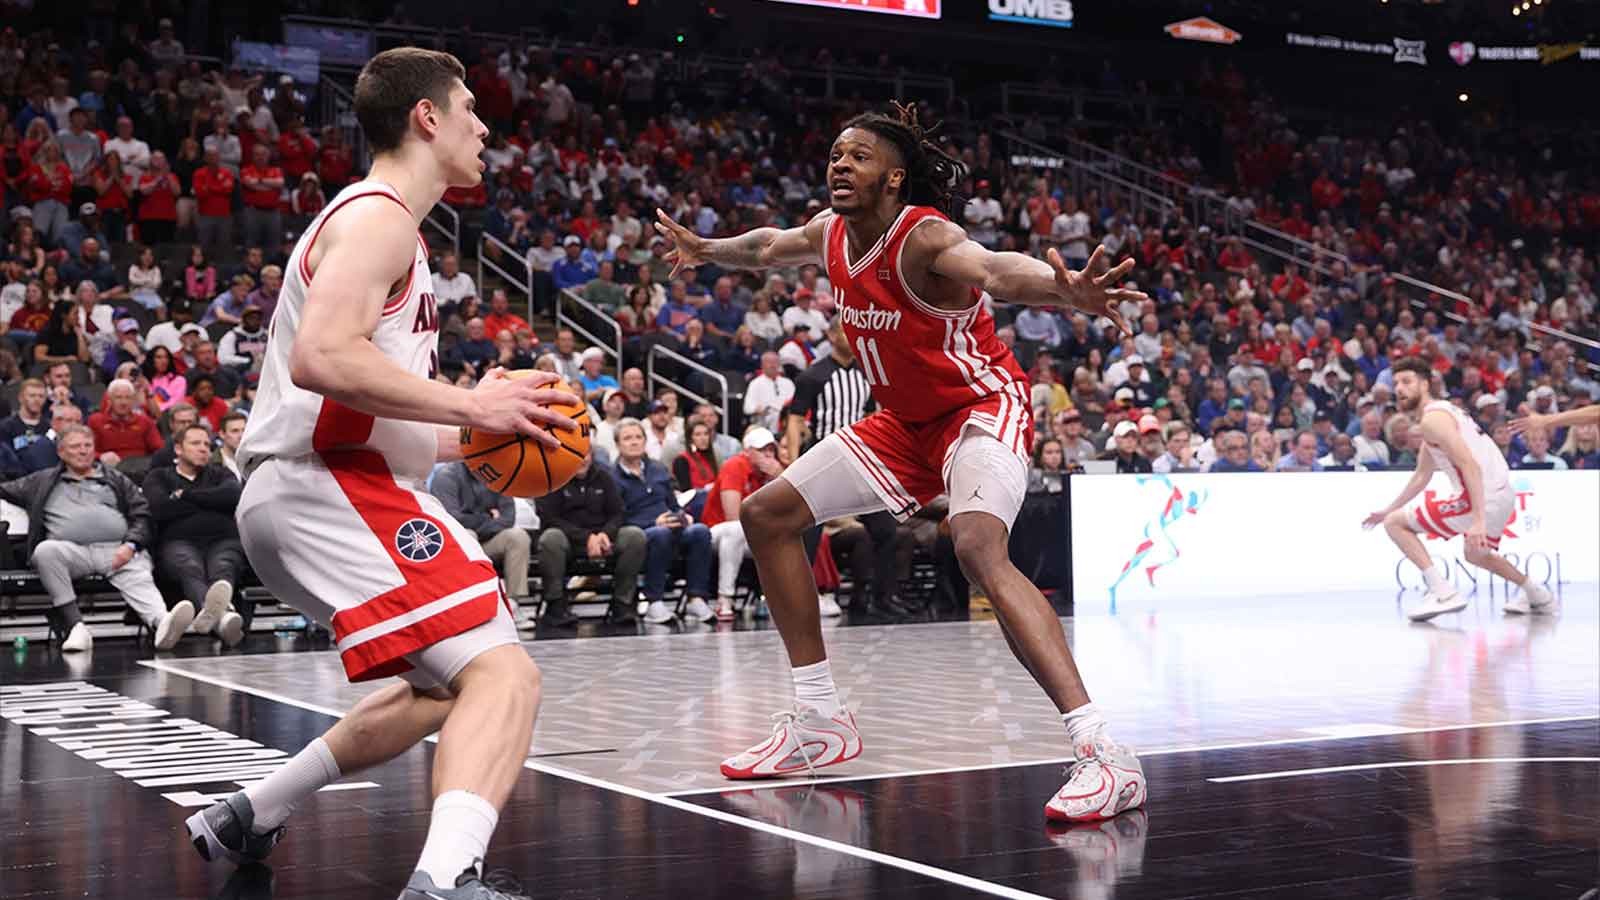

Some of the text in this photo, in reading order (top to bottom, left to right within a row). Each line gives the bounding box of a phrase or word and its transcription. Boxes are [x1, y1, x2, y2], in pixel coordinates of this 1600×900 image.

[988, 0, 1073, 21] UMB
[833, 286, 901, 331] Houston
[856, 336, 889, 386] 11
[1396, 552, 1571, 590] CONROL
